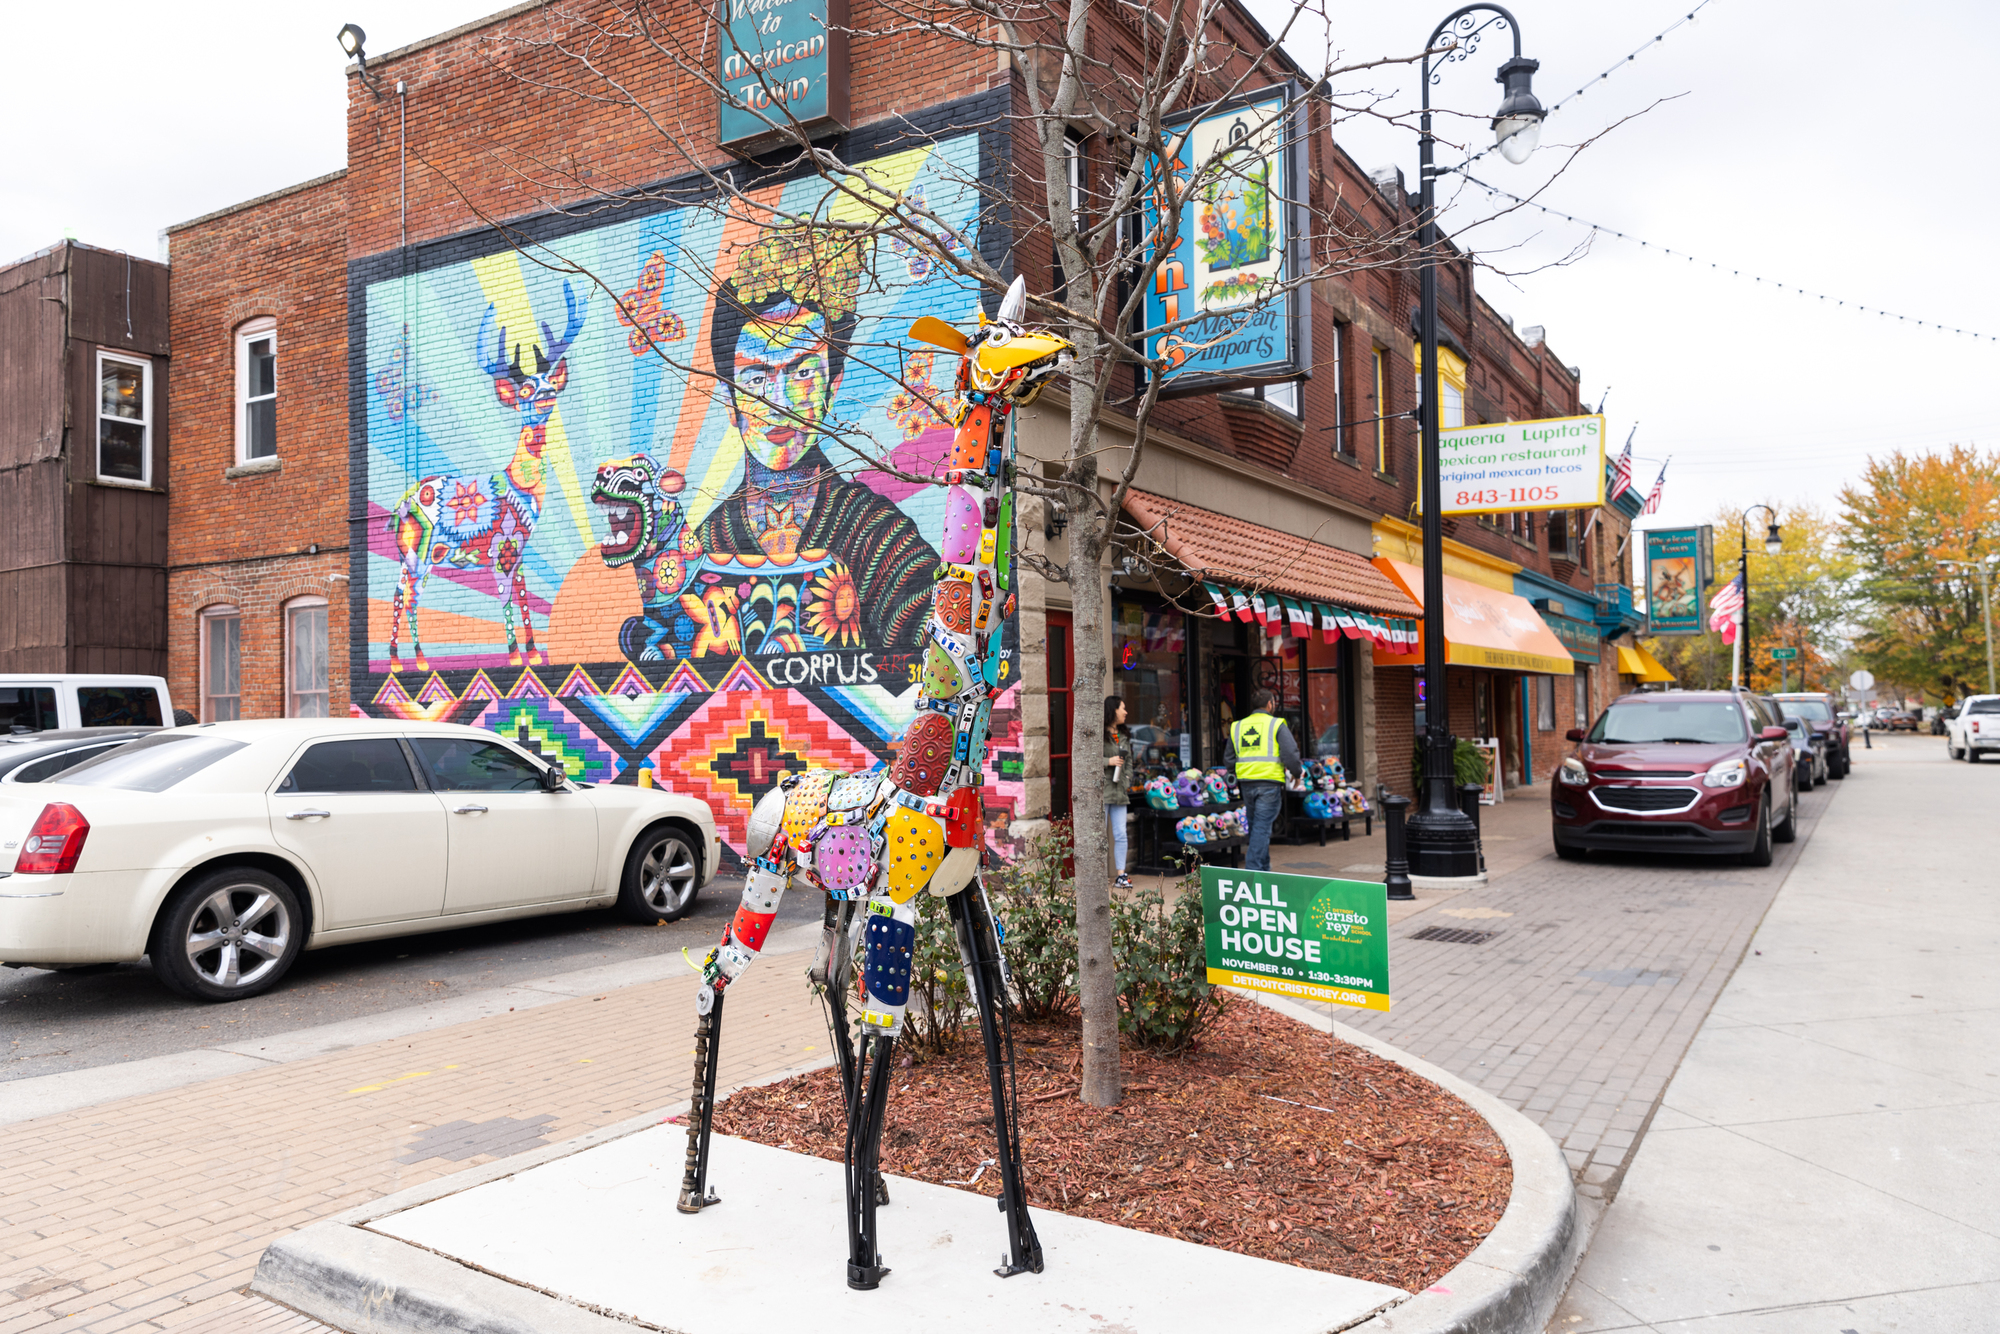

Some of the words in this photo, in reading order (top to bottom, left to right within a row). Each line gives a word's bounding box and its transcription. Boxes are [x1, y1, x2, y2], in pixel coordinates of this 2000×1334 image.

[758, 11, 783, 35] to
[724, 34, 825, 82] Mexican
[740, 76, 809, 111] Town
[1184, 310, 1278, 343] Mexican
[1194, 331, 1275, 364] Imports
[1439, 433, 1505, 451] aqueria
[1501, 444, 1588, 462] restaurant
[1439, 470, 1486, 484] original
[1488, 466, 1542, 479] mexican
[1545, 463, 1582, 475] tacos
[1455, 485, 1559, 506] 843-1105
[1648, 534, 1695, 546] Mexican
[1658, 544, 1689, 554] Town
[766, 652, 879, 685] CORPUS
[876, 653, 915, 676] ART
[1218, 879, 1287, 907] FALL
[1219, 904, 1297, 934] OPEN
[1325, 911, 1369, 925] cristo
[1325, 921, 1351, 935] rey
[1221, 929, 1321, 963] HOUSE
[1222, 957, 1279, 975] NOVEMBER
[1281, 965, 1294, 976] 10
[1308, 970, 1373, 989] 1:30-3:30PM
[1232, 974, 1367, 1005] DETROITCRISTOREY.ORG
